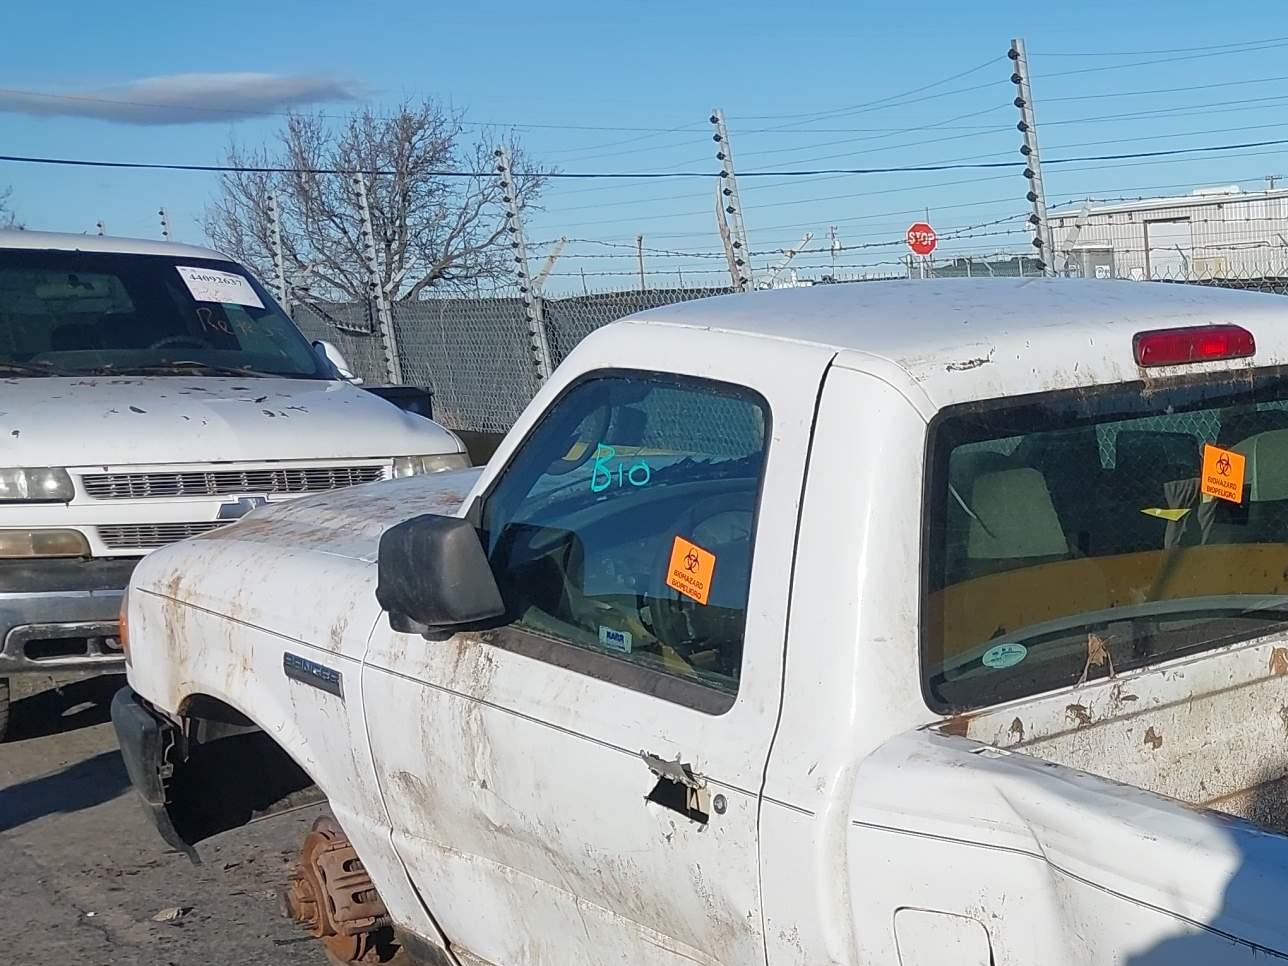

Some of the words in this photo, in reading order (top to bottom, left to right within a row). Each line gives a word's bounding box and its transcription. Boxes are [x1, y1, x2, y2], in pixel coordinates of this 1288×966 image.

[908, 231, 935, 246] STOP
[1207, 475, 1238, 491] BIOHAZARD
[1206, 485, 1237, 500] BIOPELIGRO
[673, 569, 704, 590] BIOHAZARD
[671, 579, 702, 600] BIOPELIGRO
